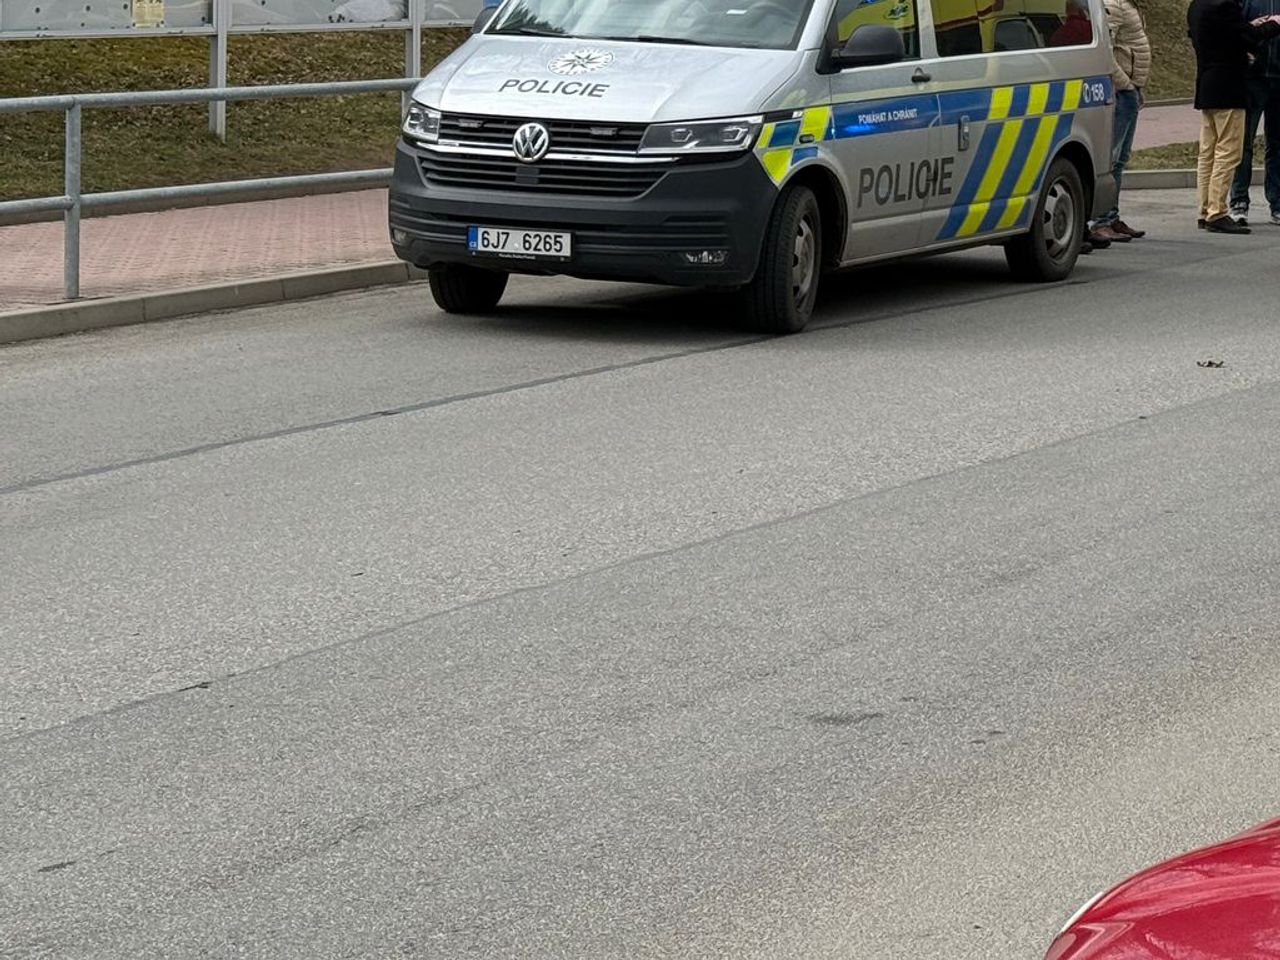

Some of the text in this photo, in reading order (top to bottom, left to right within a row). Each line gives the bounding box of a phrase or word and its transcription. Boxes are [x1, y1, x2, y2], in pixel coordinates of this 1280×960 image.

[499, 79, 610, 98] POLICIE
[1091, 83, 1105, 102] 158
[858, 107, 918, 125] POMÁHAT A CHRÁNIT
[857, 156, 955, 209] POLICIE
[481, 230, 510, 249] 6J7
[522, 233, 563, 253] 6265
